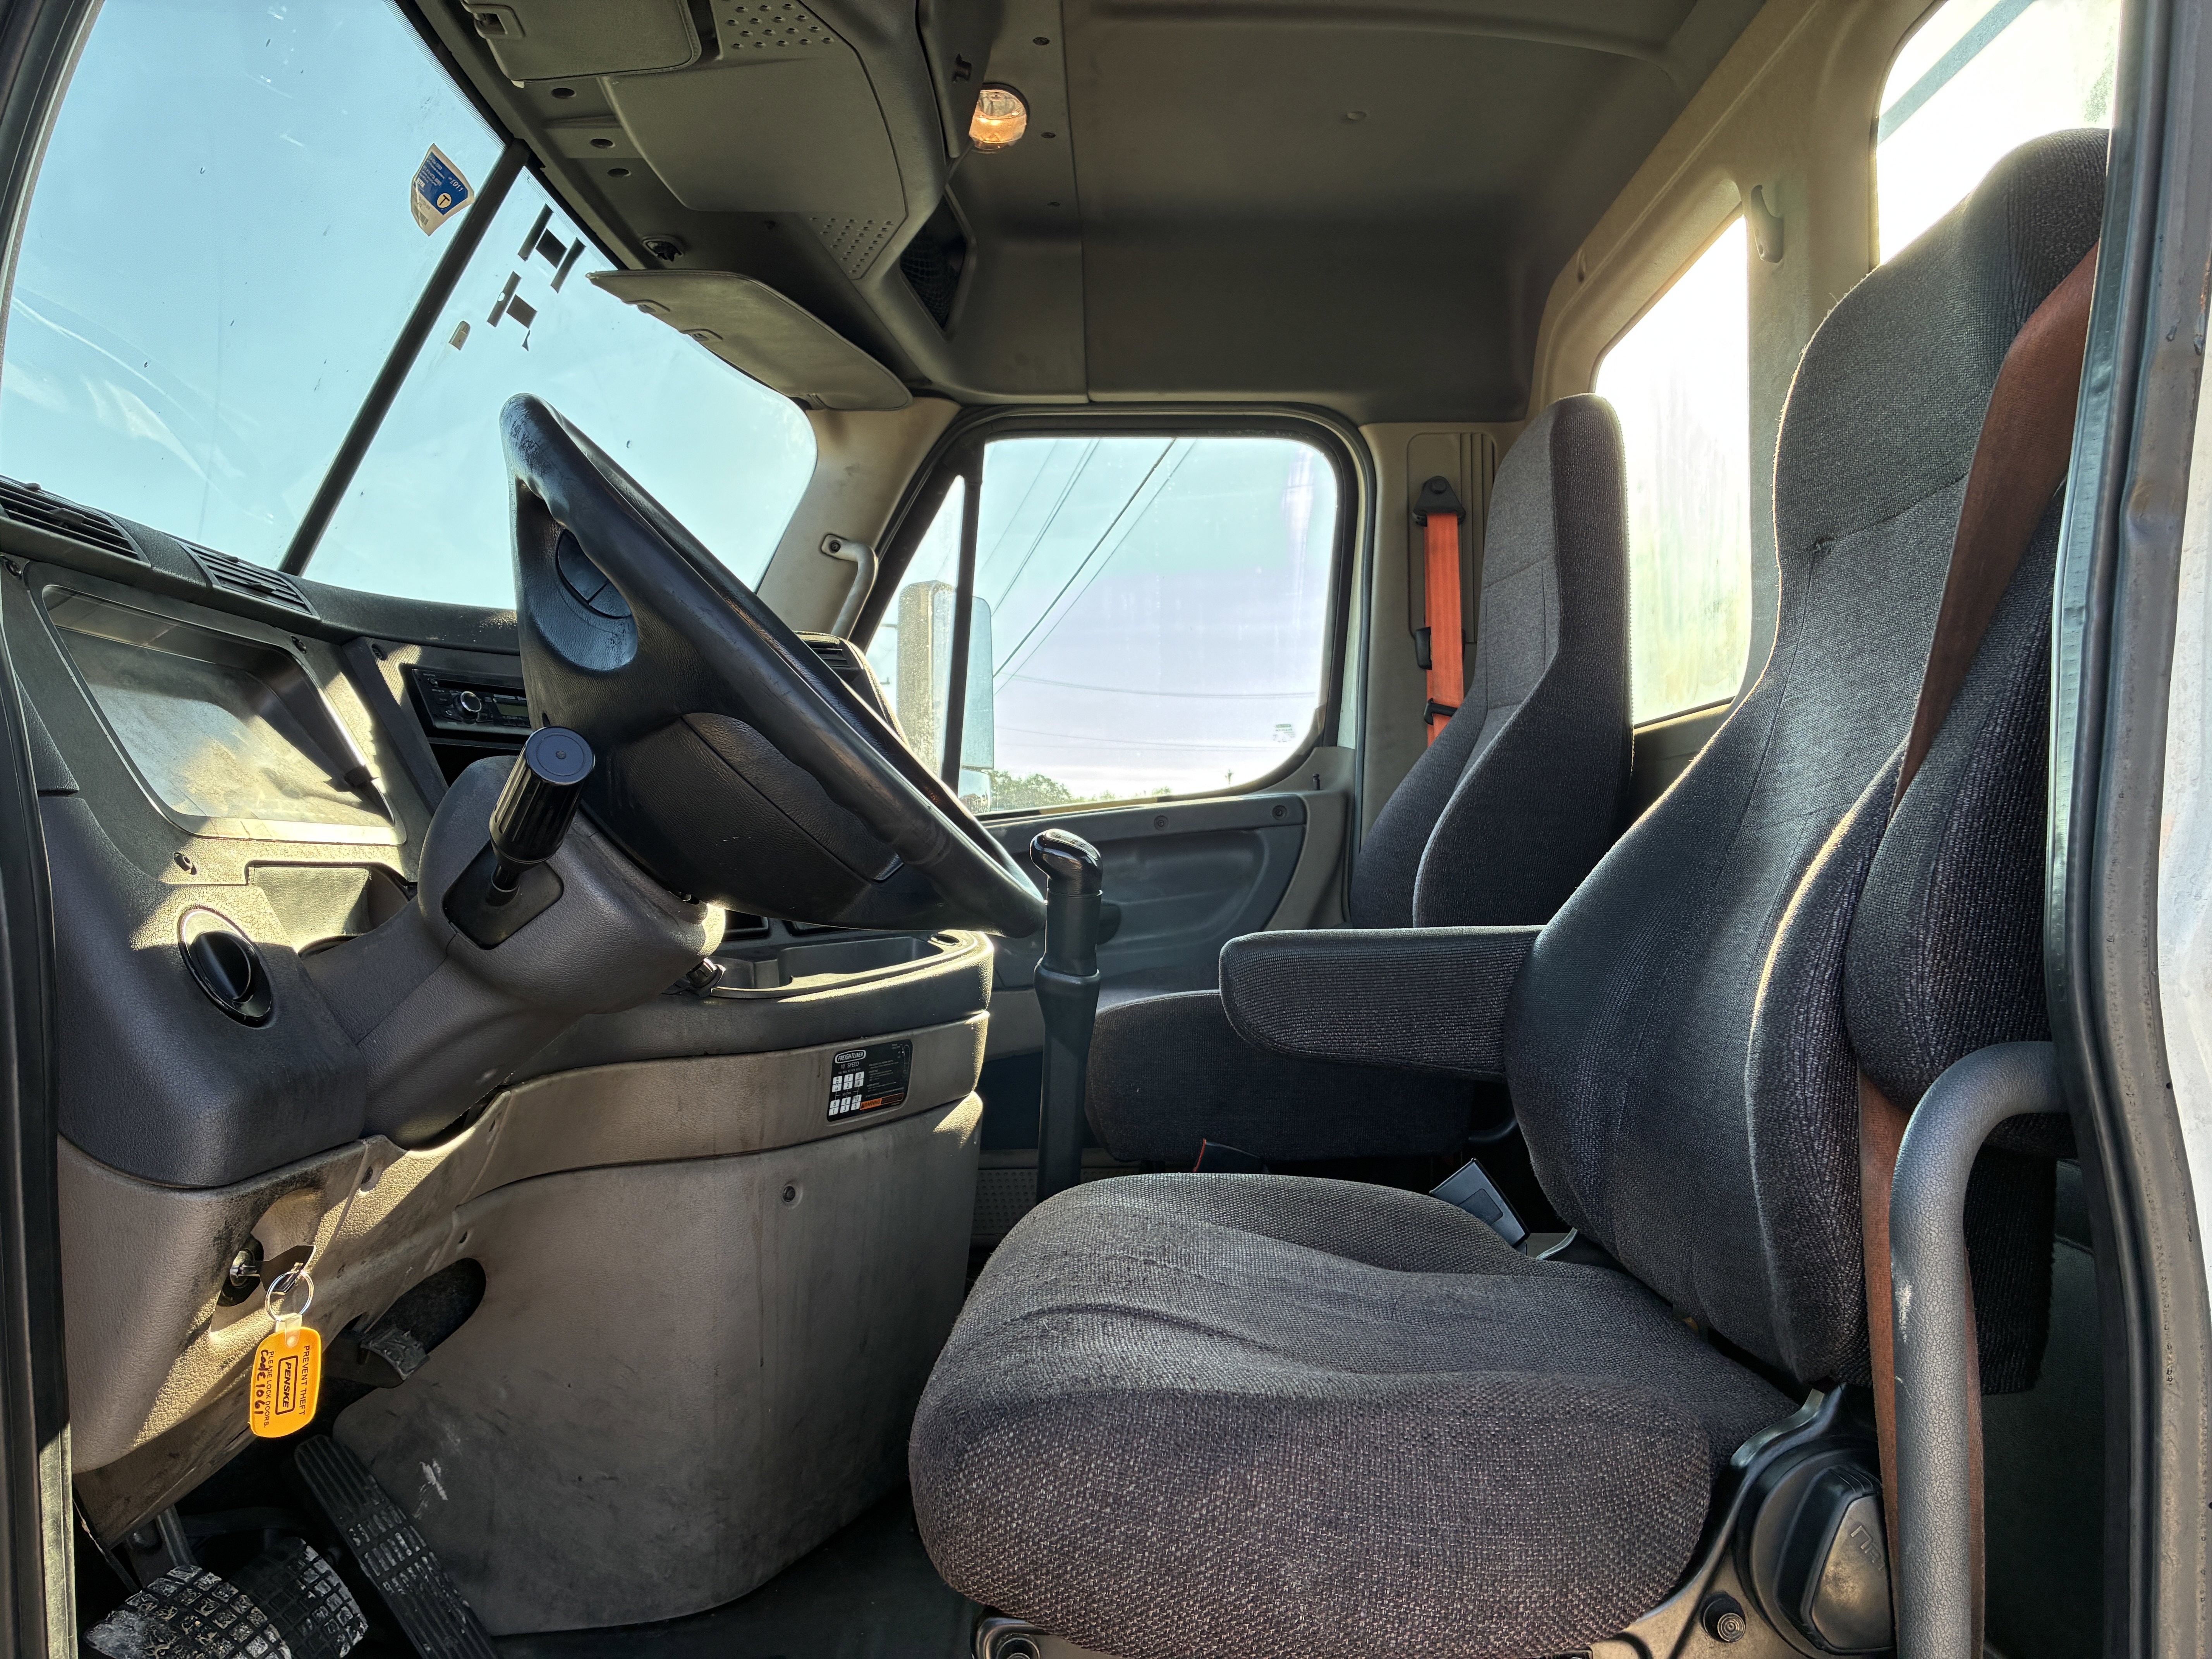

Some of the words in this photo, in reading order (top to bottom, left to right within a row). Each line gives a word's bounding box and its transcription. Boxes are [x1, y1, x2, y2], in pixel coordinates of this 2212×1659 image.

[439, 194, 450, 206] T
[838, 1052, 864, 1061] FREIGHTLINER
[301, 1345, 310, 1385] PREVENT
[283, 1362, 292, 1408] PENSKE
